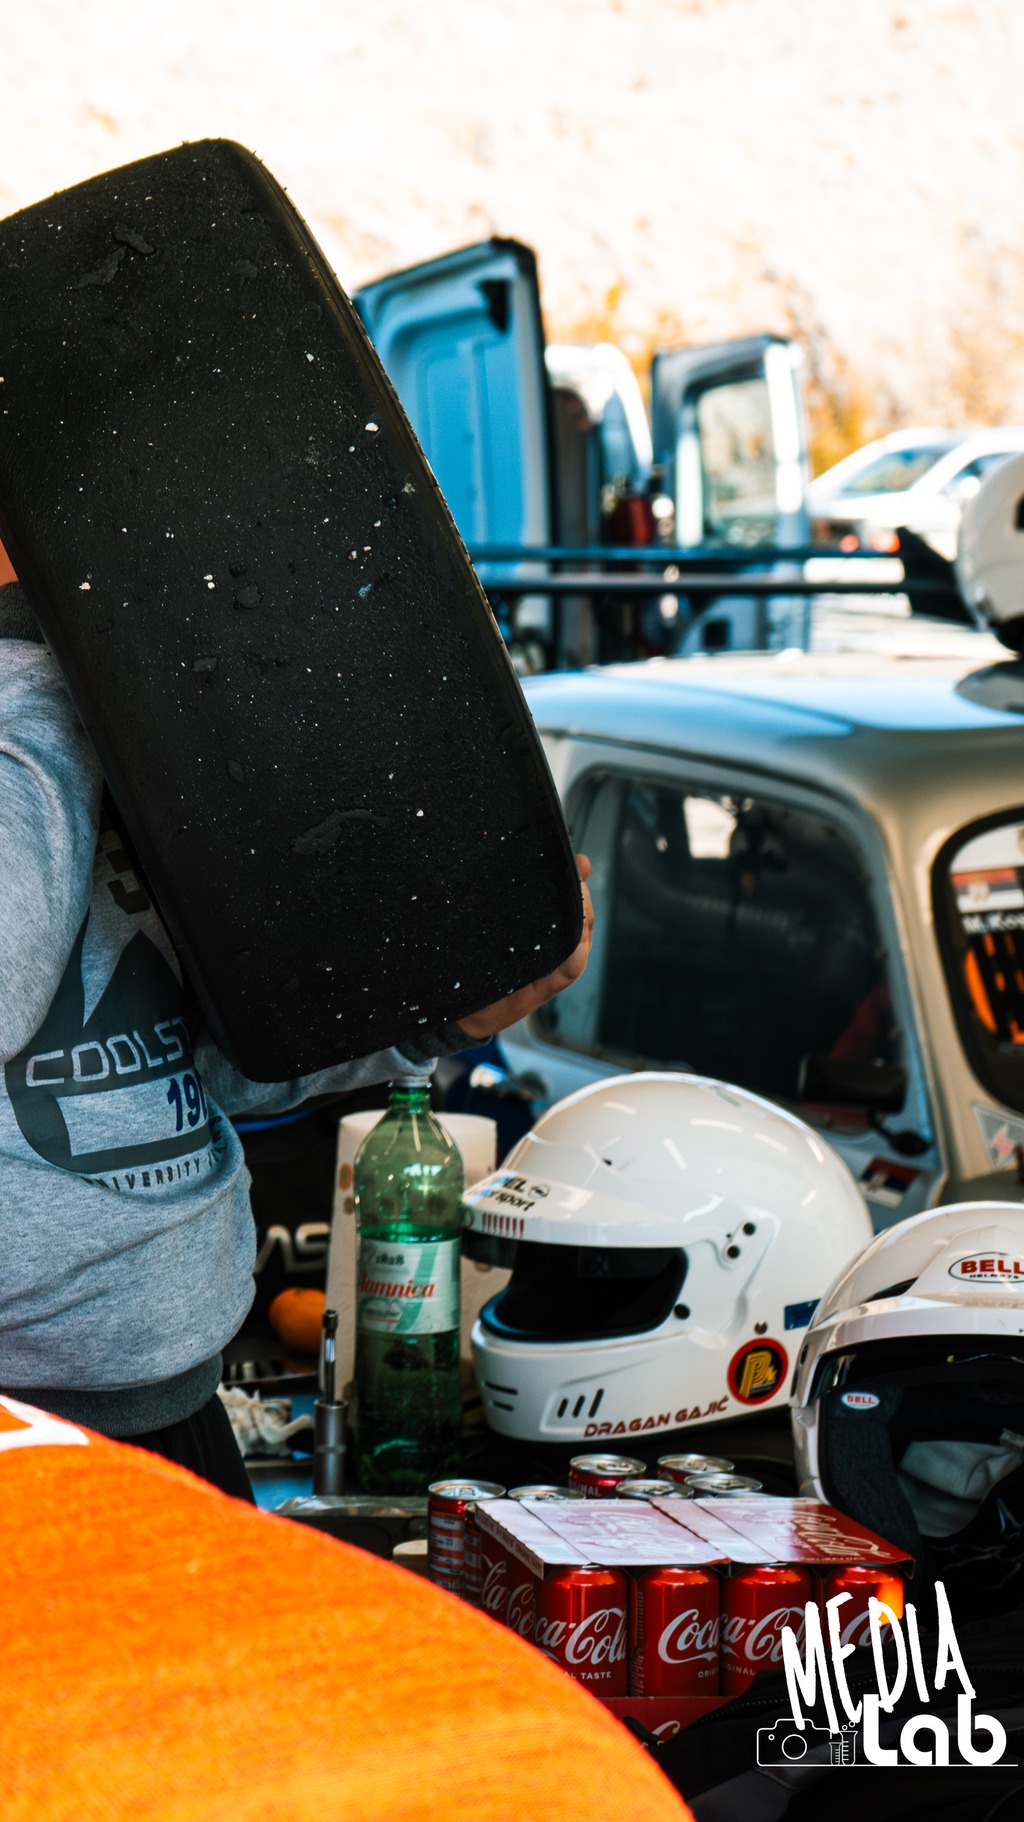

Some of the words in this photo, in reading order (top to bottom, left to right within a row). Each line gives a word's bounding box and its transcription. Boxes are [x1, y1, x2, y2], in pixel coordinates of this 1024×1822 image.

[961, 1259, 1024, 1276] BELL
[846, 1394, 876, 1405] BELL
[584, 1413, 671, 1438] DRAGAN
[674, 1396, 729, 1424] GAJIĆ
[580, 1671, 612, 1680] TASTE
